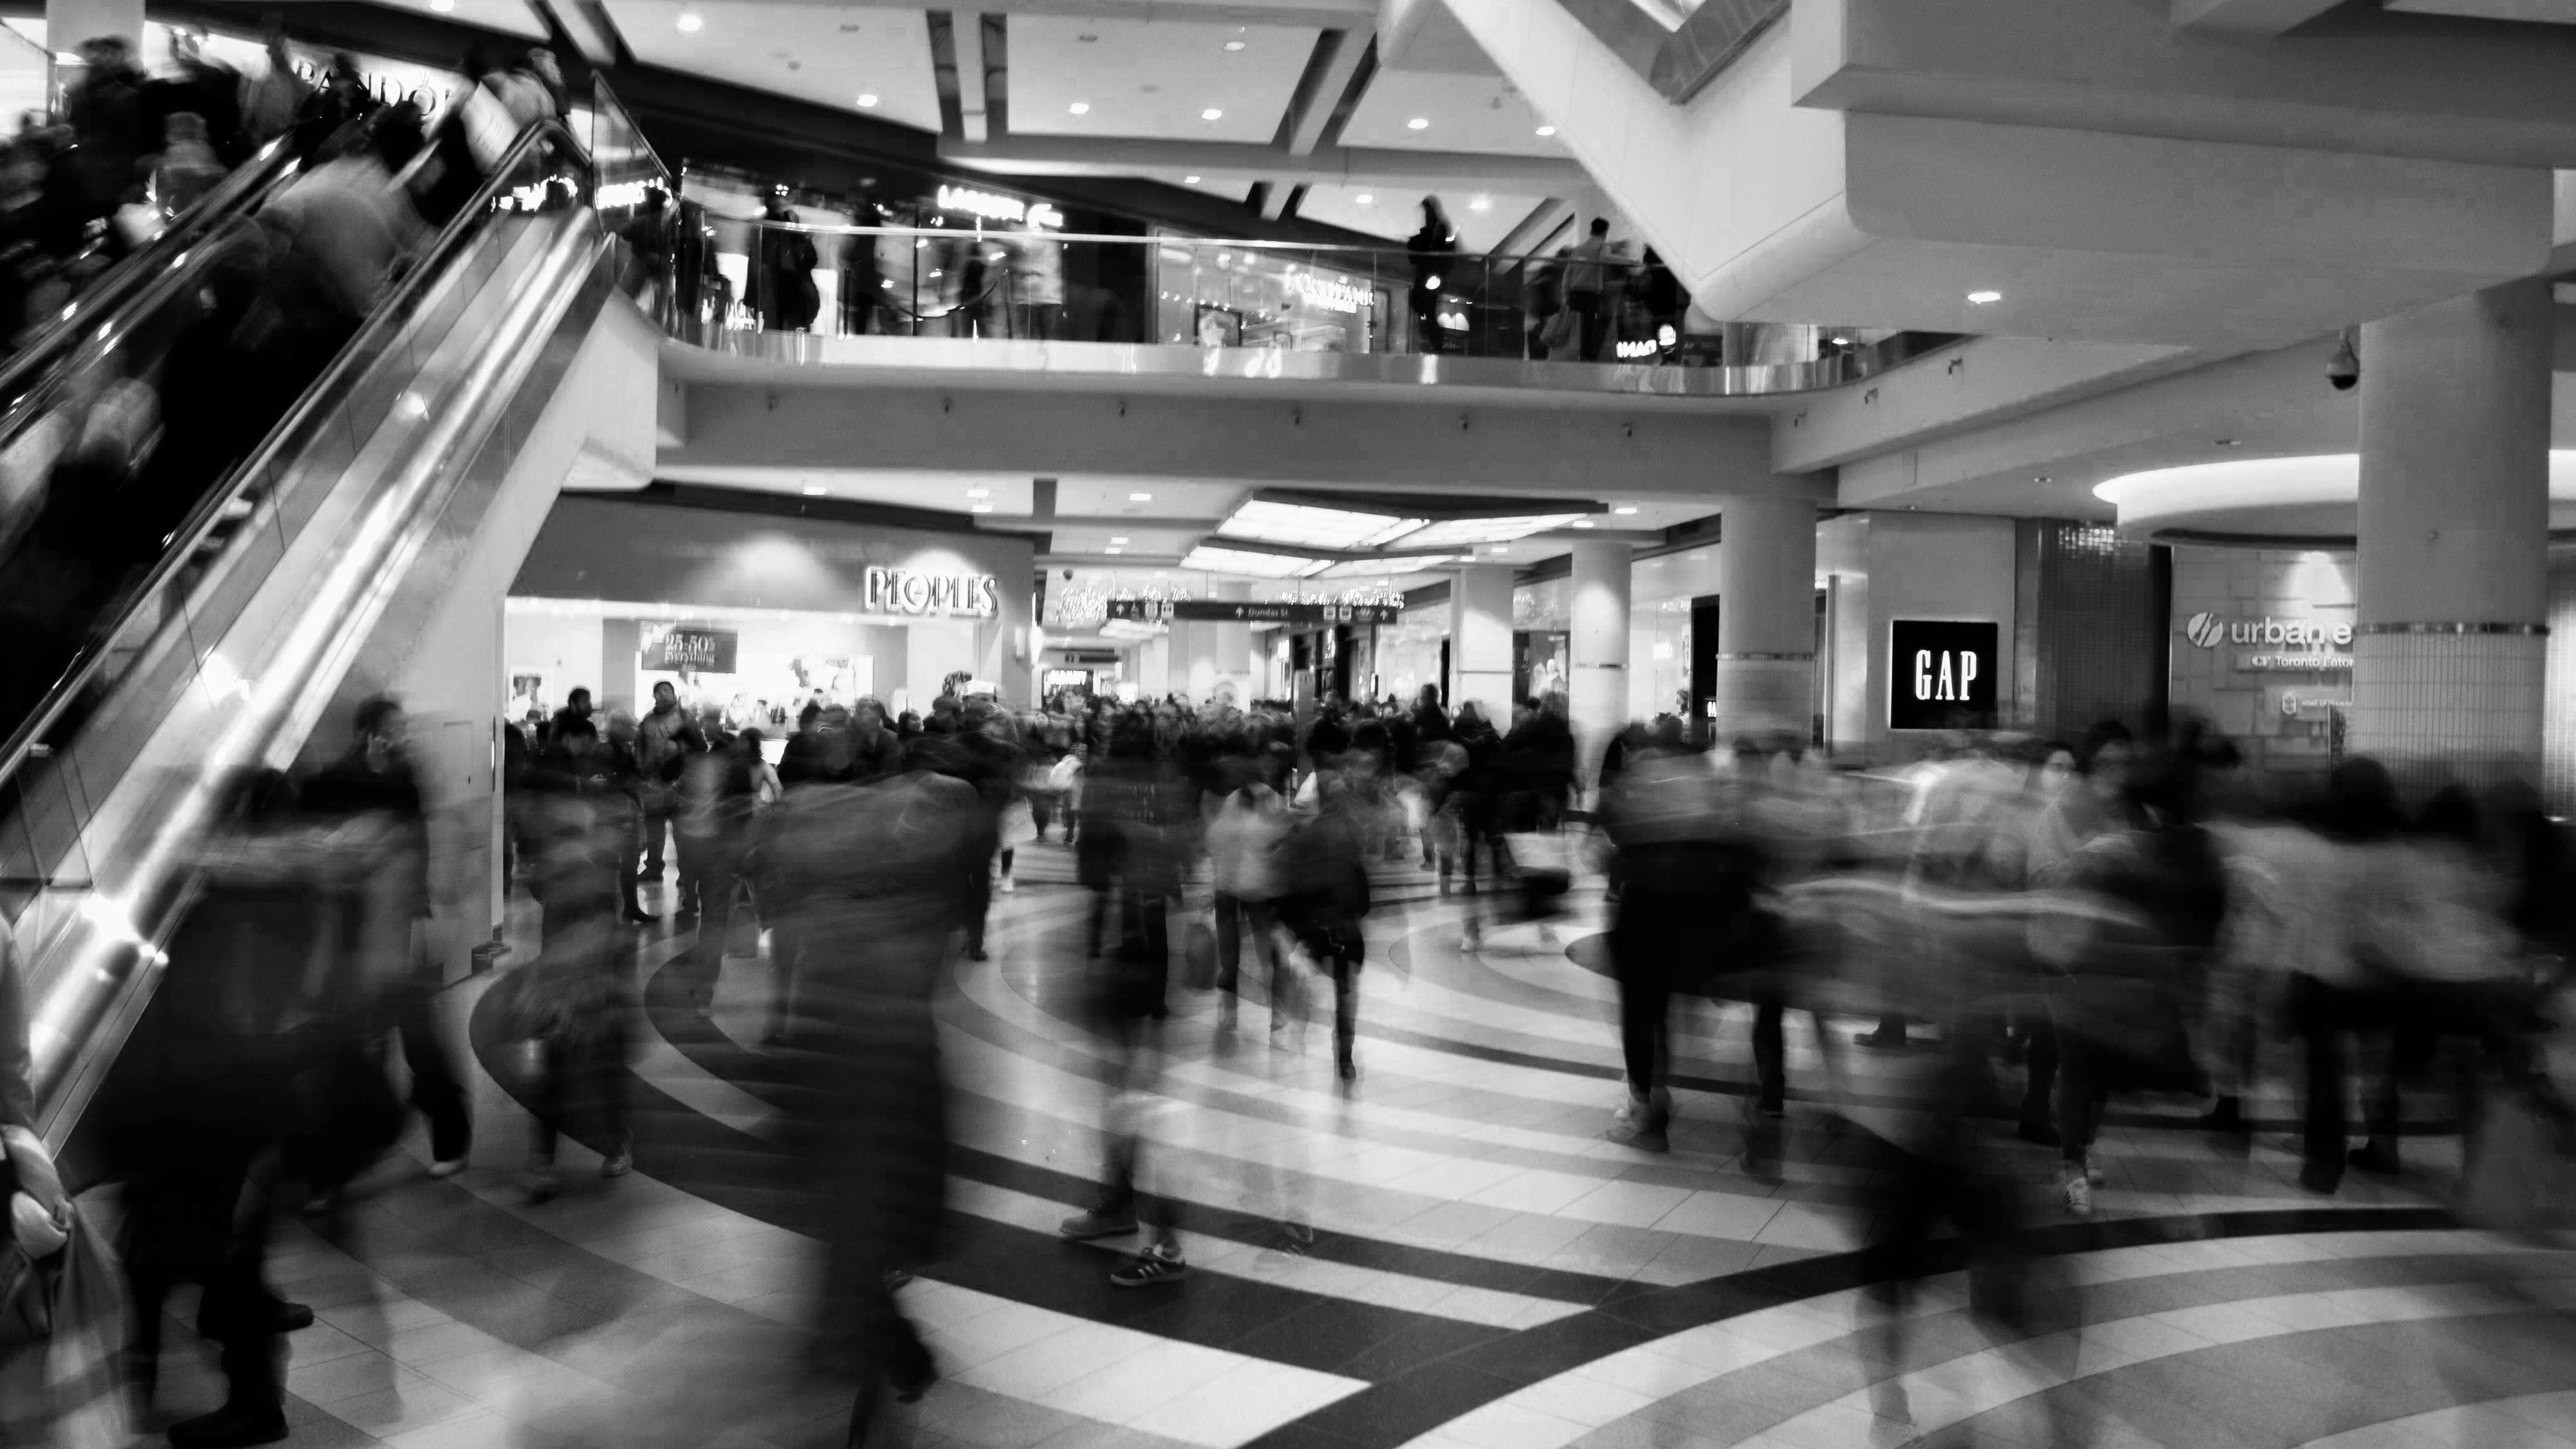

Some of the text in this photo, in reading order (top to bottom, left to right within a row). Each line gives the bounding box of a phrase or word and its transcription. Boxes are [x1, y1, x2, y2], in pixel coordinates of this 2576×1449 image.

[866, 566, 1000, 618] PEOPLES
[2232, 616, 2324, 645] urban
[1915, 650, 1977, 701] GAP
[2275, 655, 2320, 667] Toronto
